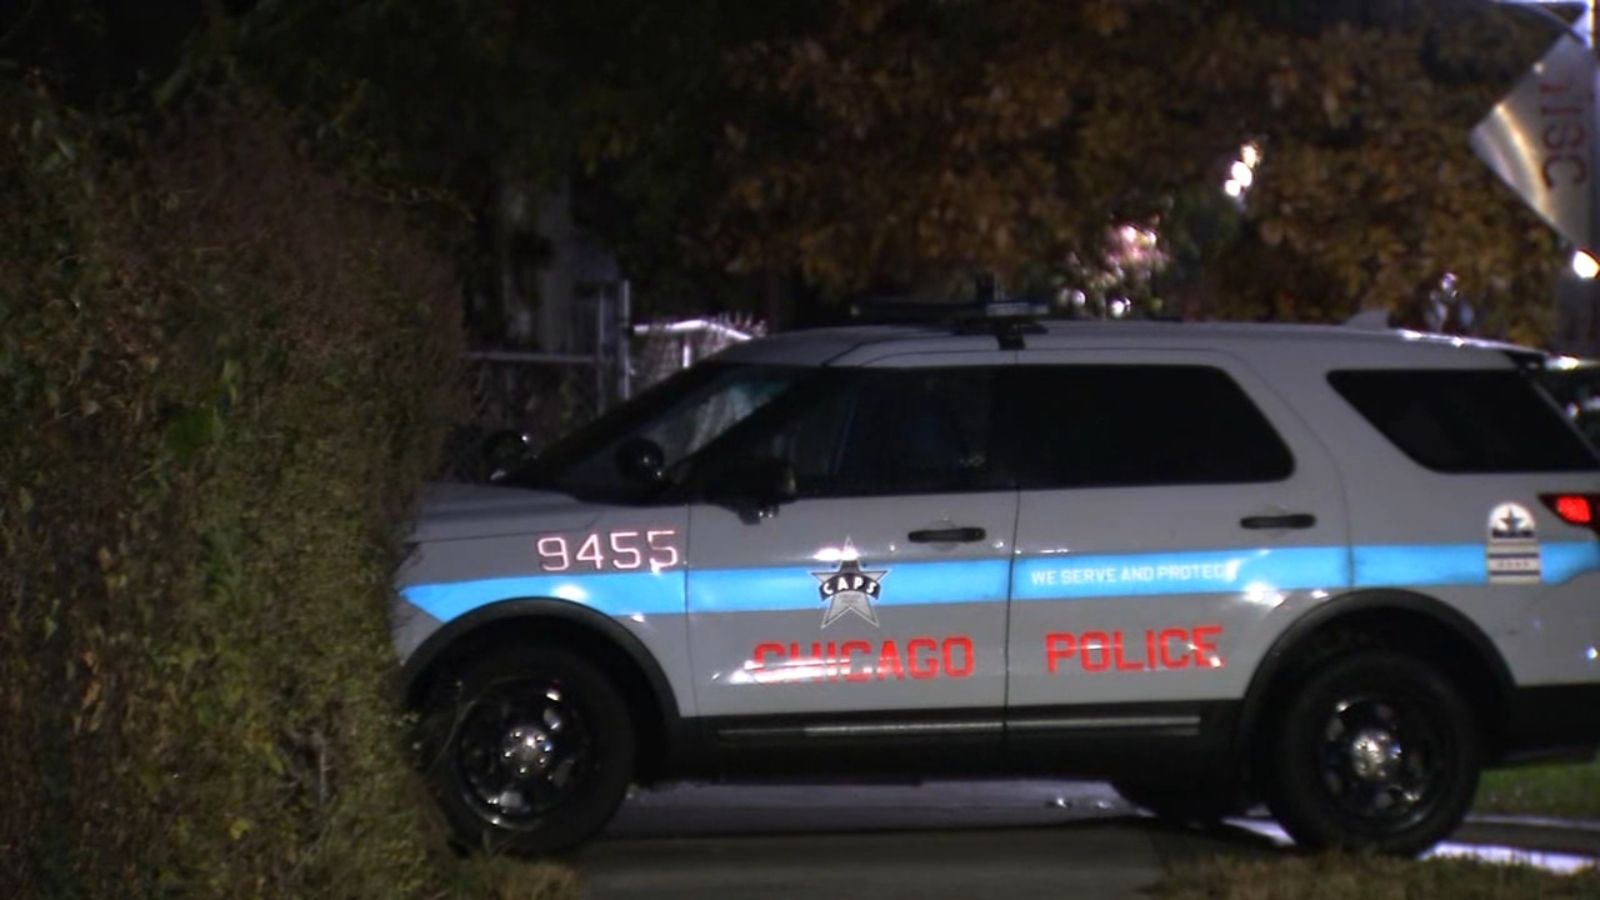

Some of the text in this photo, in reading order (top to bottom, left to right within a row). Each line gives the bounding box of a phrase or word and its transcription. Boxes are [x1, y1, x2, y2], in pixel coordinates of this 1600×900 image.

[537, 530, 678, 571] 9455
[823, 576, 877, 595] CAPS
[1031, 570, 1058, 586] WE
[1061, 567, 1118, 585] SERVE
[1121, 564, 1155, 582] AND
[754, 625, 1225, 684] CHICAGO POLICE
